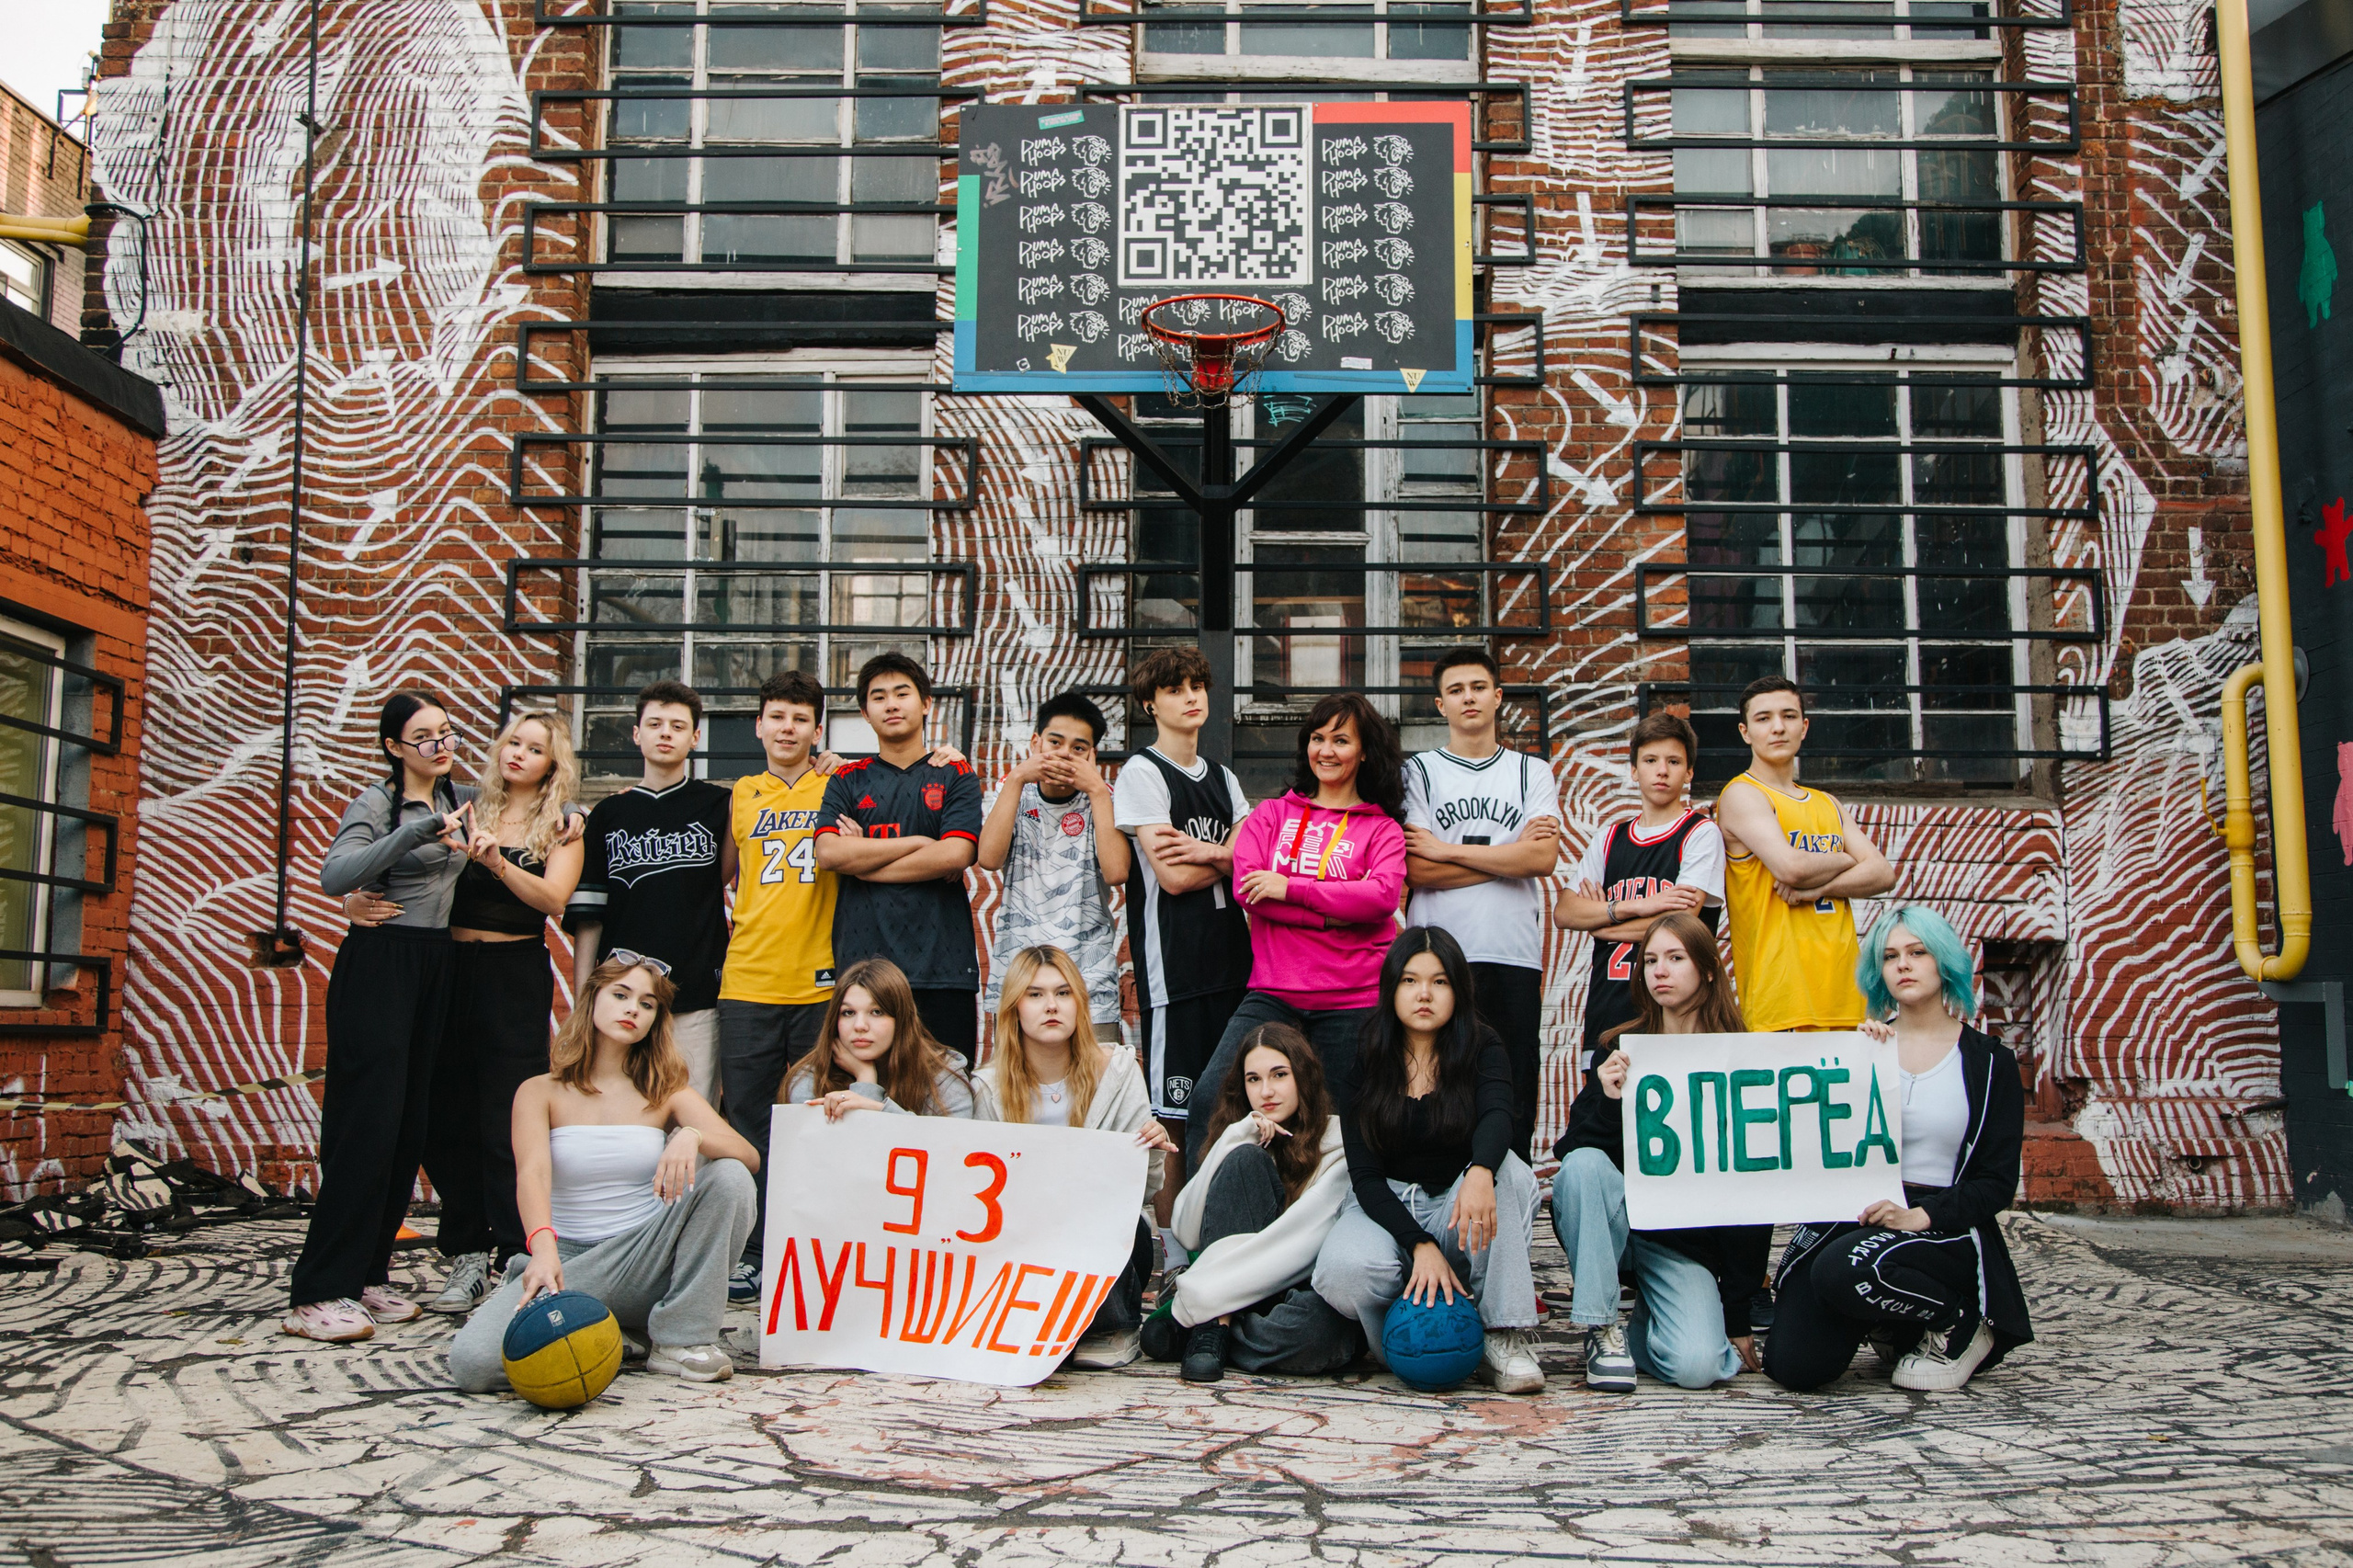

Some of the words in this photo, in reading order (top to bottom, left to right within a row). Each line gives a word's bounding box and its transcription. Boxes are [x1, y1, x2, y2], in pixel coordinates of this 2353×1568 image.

[1021, 136, 1060, 162] PUMA
[1029, 143, 1066, 166] HOOPS
[1323, 136, 1361, 162] PUMA
[1330, 143, 1368, 165] HOOPS
[1020, 168, 1060, 193] PUMA
[1028, 175, 1066, 198] HOOPS
[1323, 168, 1361, 194] PUMA
[1330, 175, 1368, 198] HOOPS
[1020, 203, 1059, 228] PUMA
[1028, 210, 1065, 233] HOOPS
[1323, 203, 1361, 229] PUMA
[1330, 210, 1368, 233] HOOPS
[1018, 238, 1058, 264] PUMA
[1026, 244, 1064, 267] HOOPS
[1323, 238, 1361, 264] PUMA
[1330, 245, 1369, 268] HOOPS
[1018, 274, 1057, 300] PUMA
[1026, 281, 1063, 304] HOOPS
[1323, 274, 1362, 300] PUMA
[1330, 281, 1369, 304] HOOPS
[1119, 294, 1158, 321] PUMA
[1018, 312, 1057, 336] PUMA
[1026, 318, 1063, 341] HOOPS
[1323, 312, 1362, 337] PUMA
[1330, 319, 1369, 342] HOOPS
[1118, 333, 1149, 358] PUM
[749, 808, 819, 839] LAKER
[1435, 797, 1523, 832] BROOKLYN
[606, 822, 714, 868] Raised
[760, 836, 816, 885] 24
[1608, 942, 1638, 981] 2
[1169, 1078, 1190, 1091] NETS
[1635, 1057, 1899, 1176] ВПЕРЁД
[1847, 1232, 1896, 1267] SPORT
